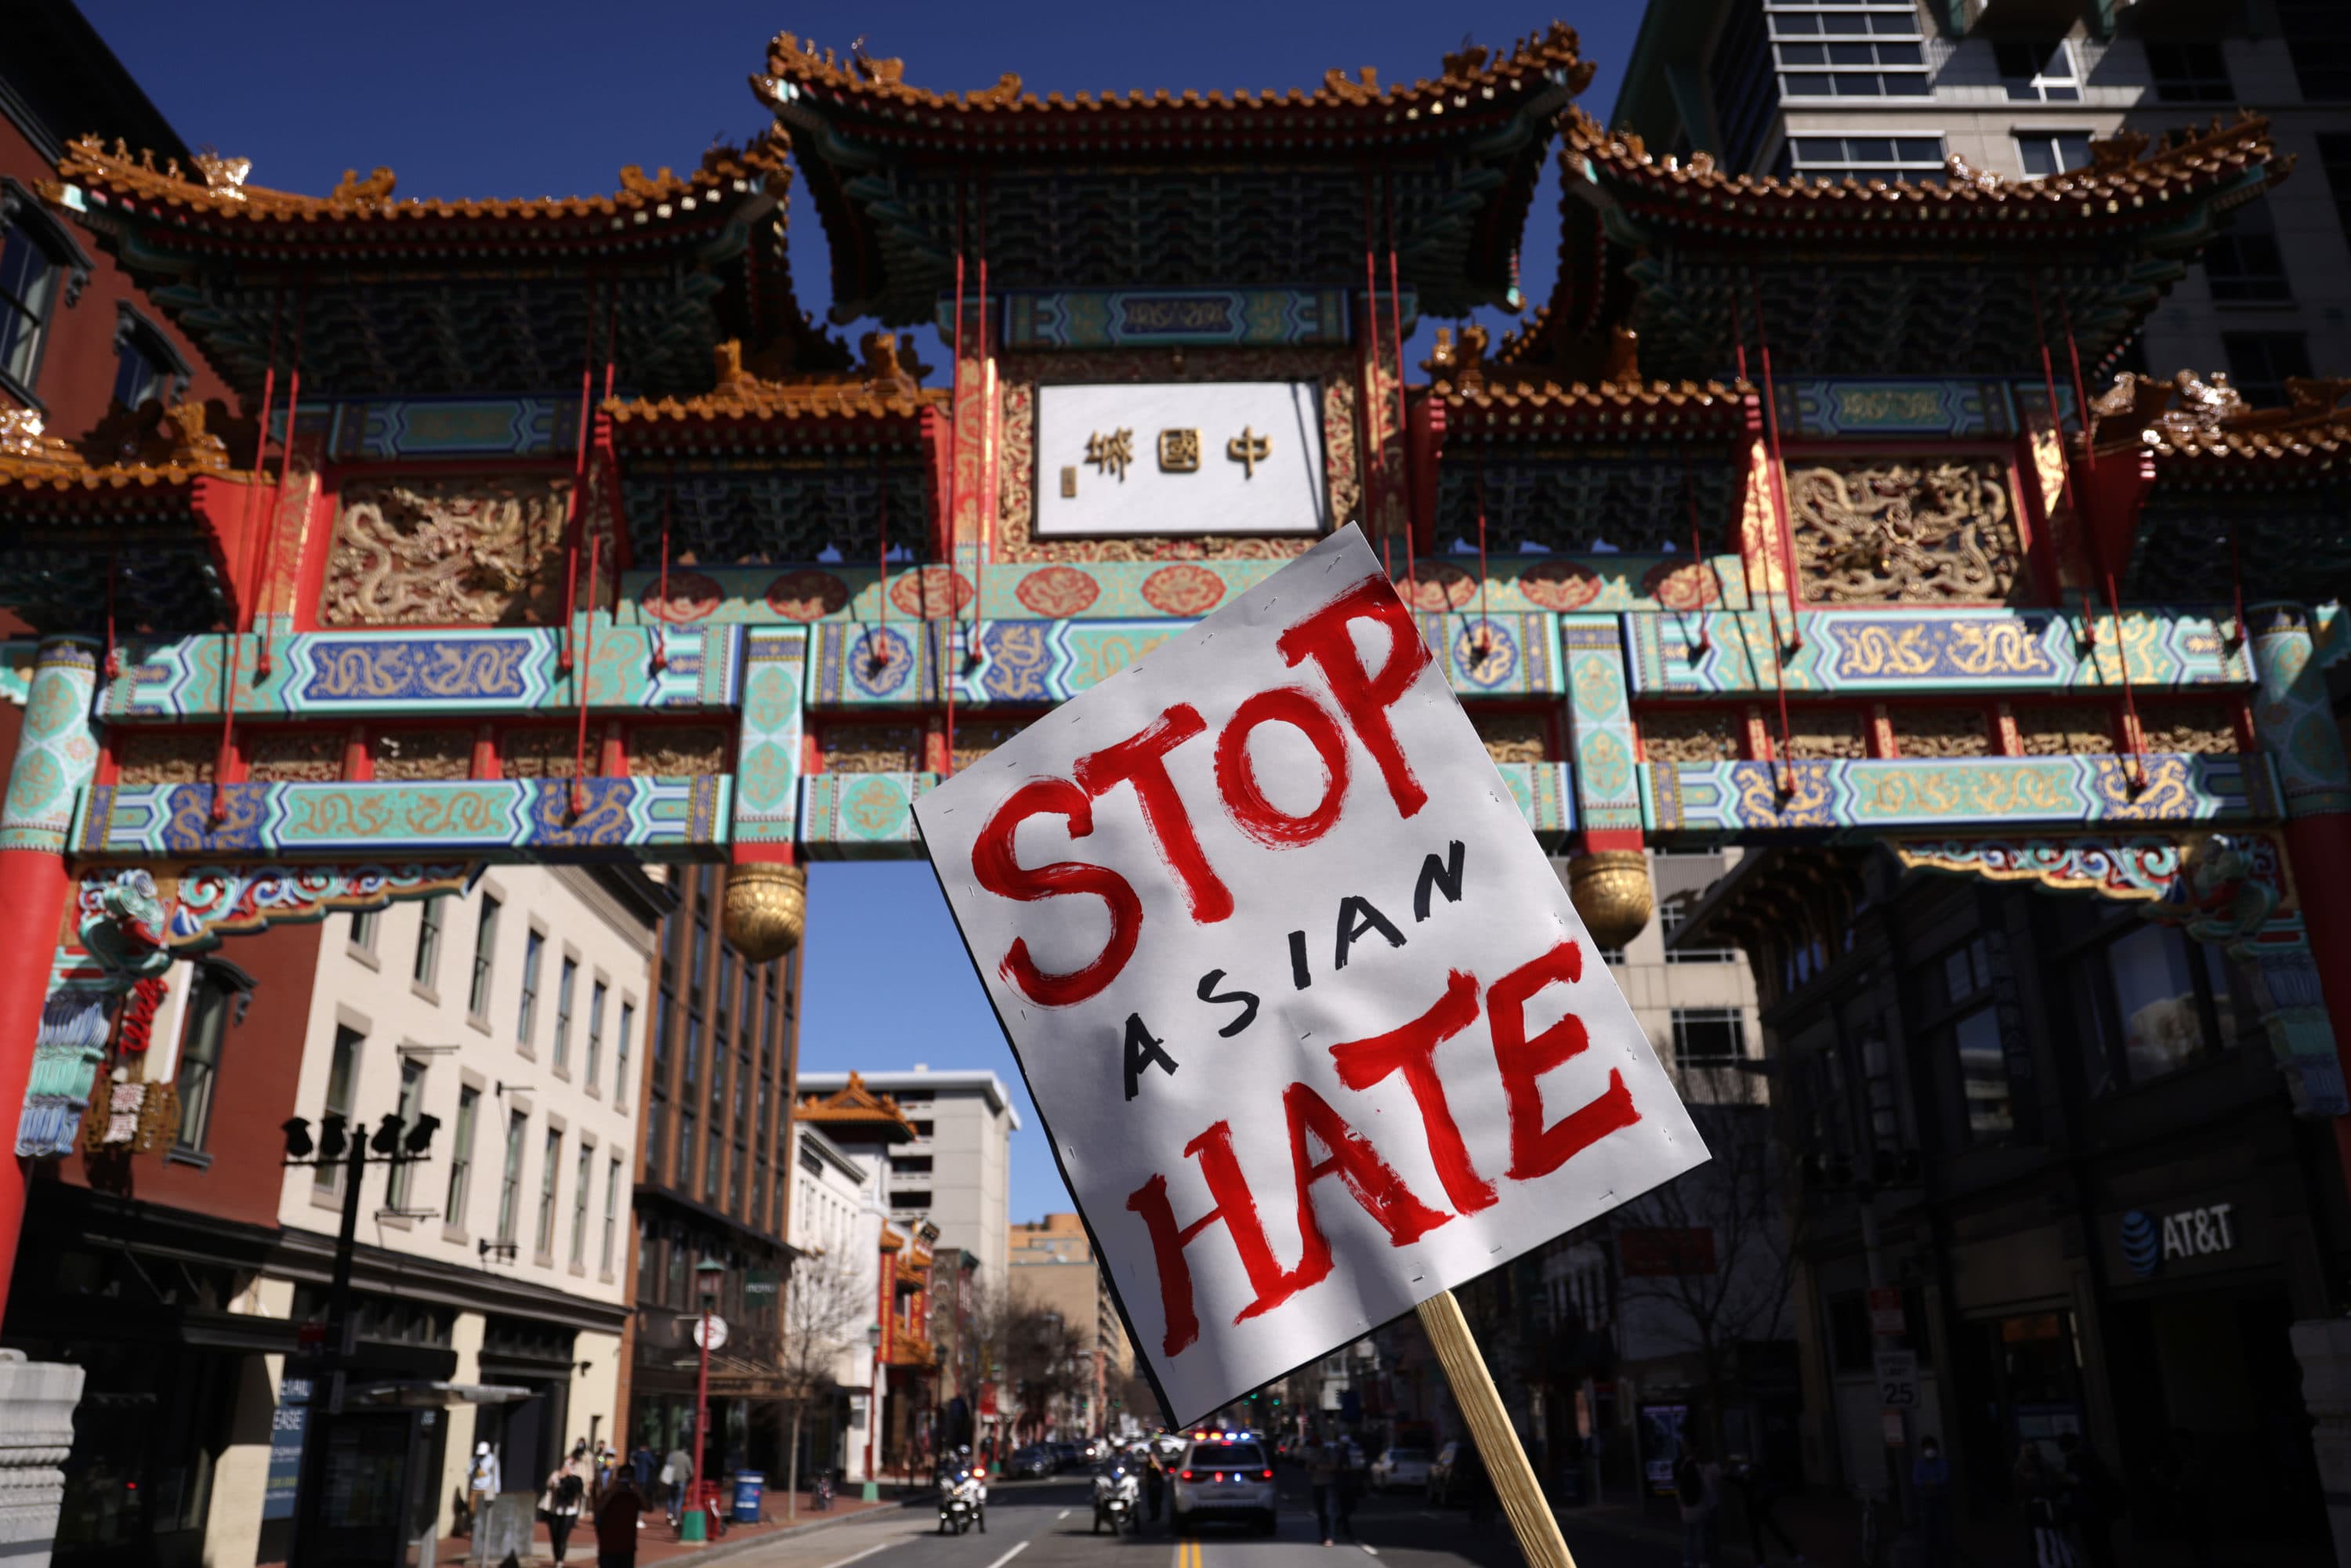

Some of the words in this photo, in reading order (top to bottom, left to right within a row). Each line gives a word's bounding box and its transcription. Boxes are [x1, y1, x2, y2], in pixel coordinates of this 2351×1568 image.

[972, 573, 1433, 1006] STOP
[1124, 841, 1464, 1101] ASIAN
[1126, 941, 1641, 1357] HATE
[2161, 1202, 2233, 1261] AT&T
[1884, 1384, 1914, 1403] 25
